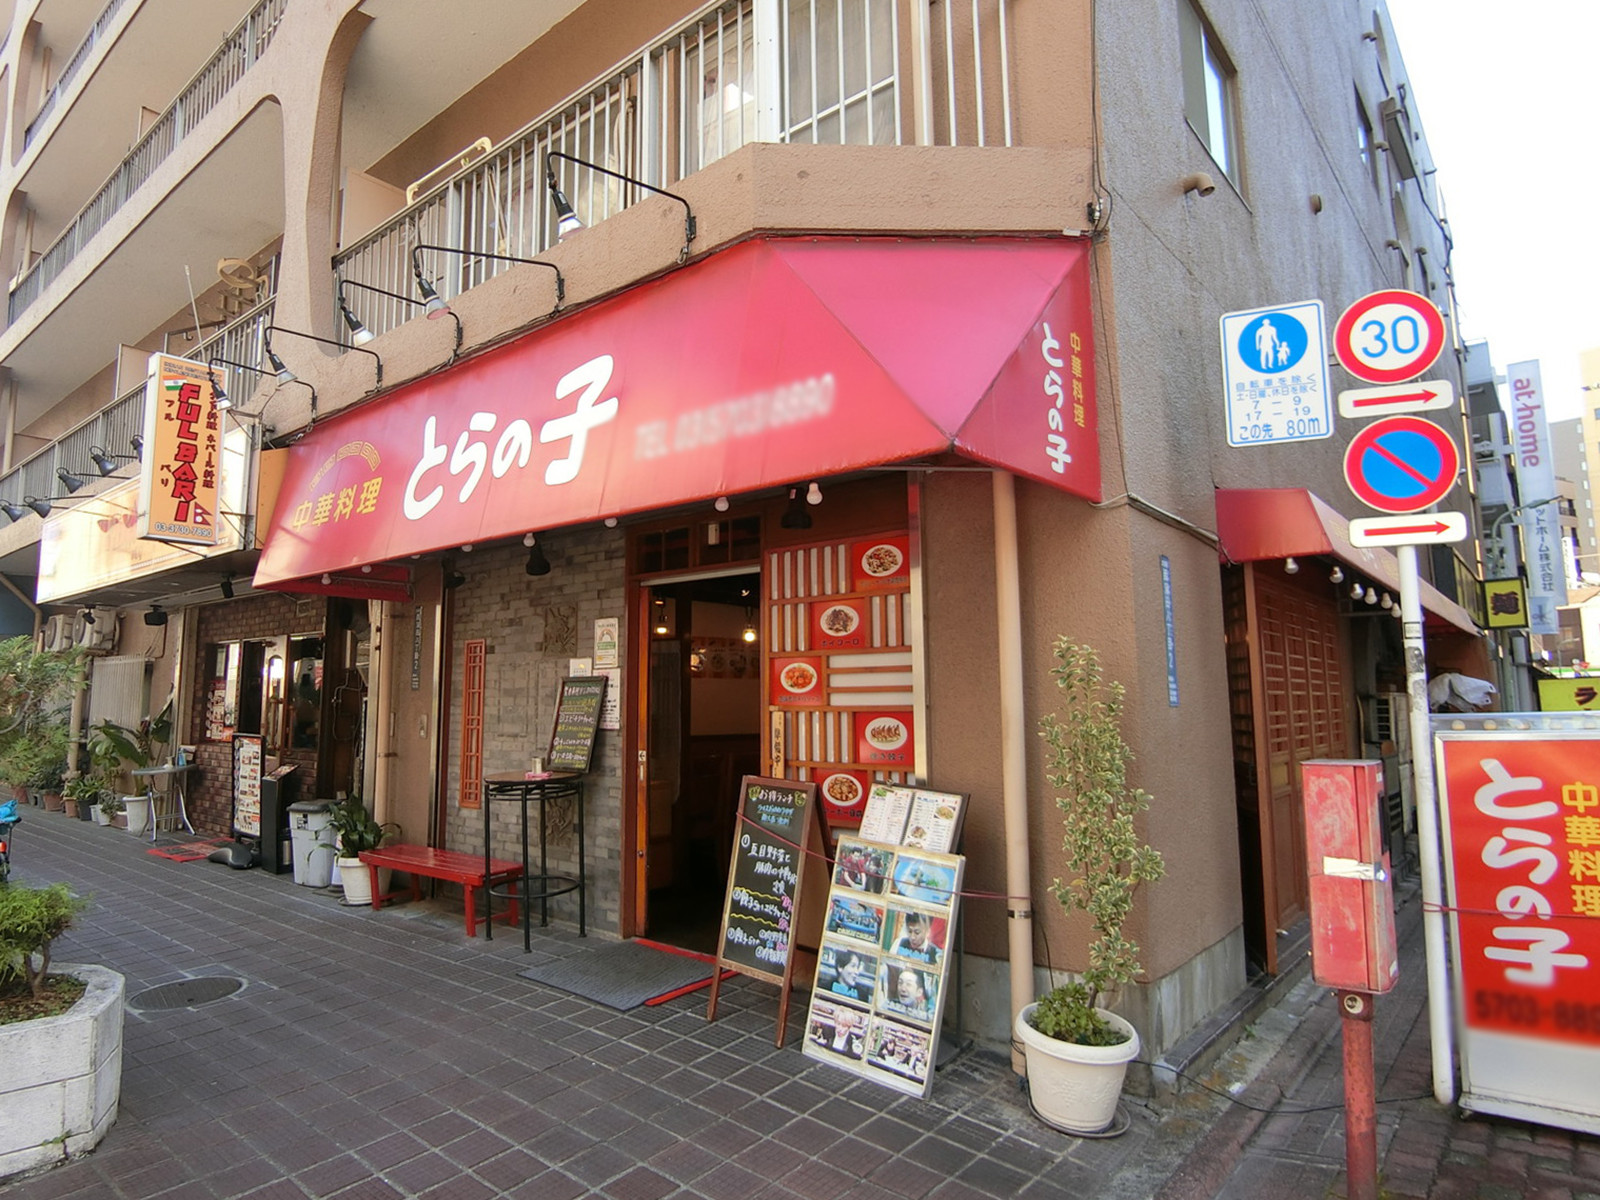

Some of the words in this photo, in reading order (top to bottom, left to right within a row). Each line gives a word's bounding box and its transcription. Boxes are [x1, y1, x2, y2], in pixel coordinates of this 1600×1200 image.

[1070, 331, 1085, 428] 中華料理
[1236, 373, 1317, 392] 自転車を除く
[1361, 315, 1420, 358] 30
[171, 383, 202, 523] FULBARI
[403, 354, 619, 521] とらの子
[1041, 322, 1072, 474] とらの子
[1239, 423, 1274, 441] この先
[1286, 417, 1321, 437] 80m
[291, 476, 383, 532] 中華料理
[1474, 758, 1589, 987] とらの子
[1562, 781, 1600, 918] 中華料理
